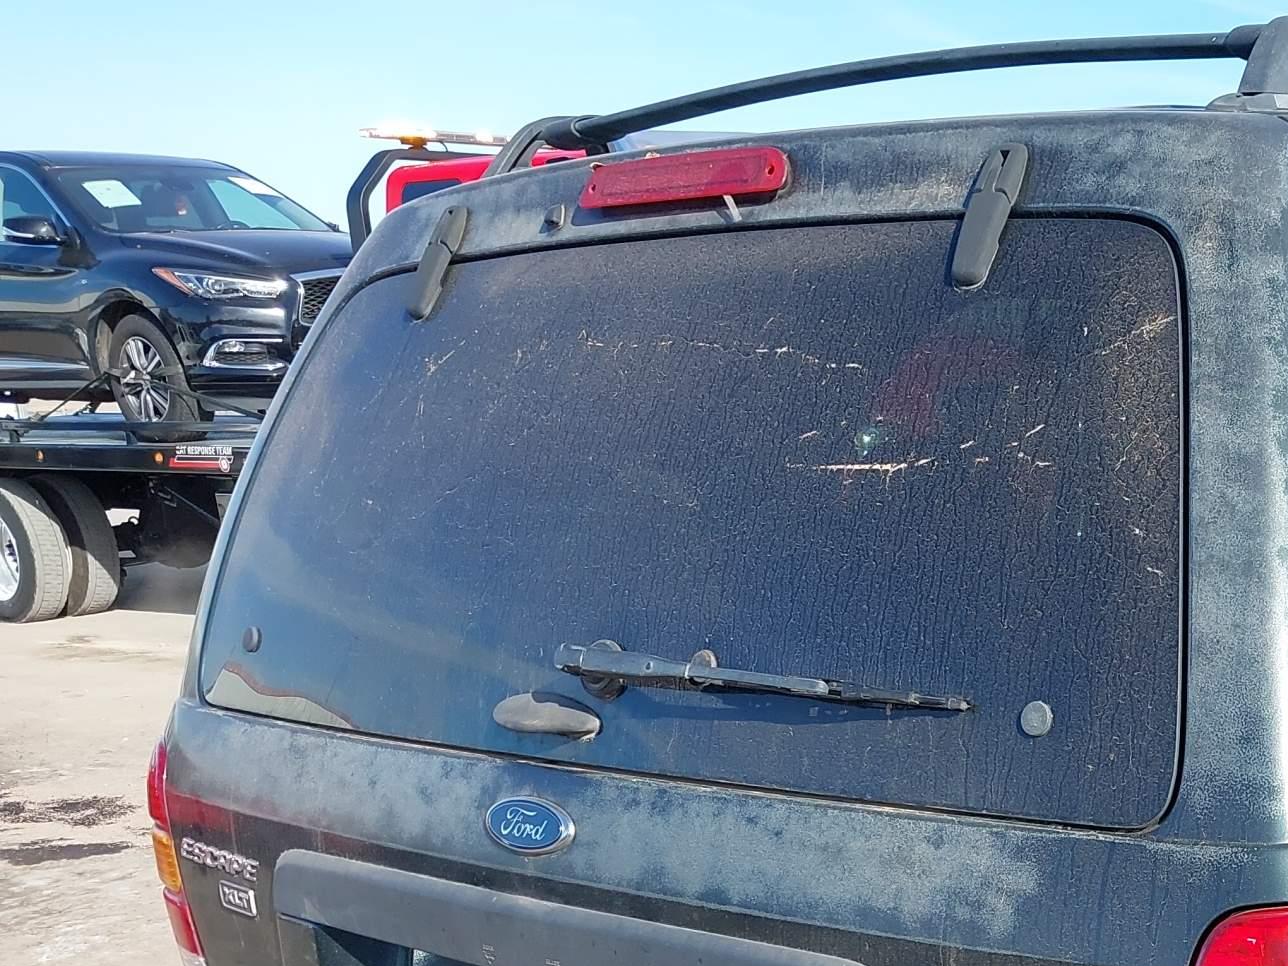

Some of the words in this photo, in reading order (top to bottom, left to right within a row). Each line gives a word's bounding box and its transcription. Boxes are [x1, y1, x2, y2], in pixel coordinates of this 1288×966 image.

[187, 445, 216, 455] RESPONSE
[216, 446, 233, 455] TEAM
[501, 806, 548, 840] Ford
[181, 837, 260, 881] ESCAPE
[223, 886, 249, 909] XLT
